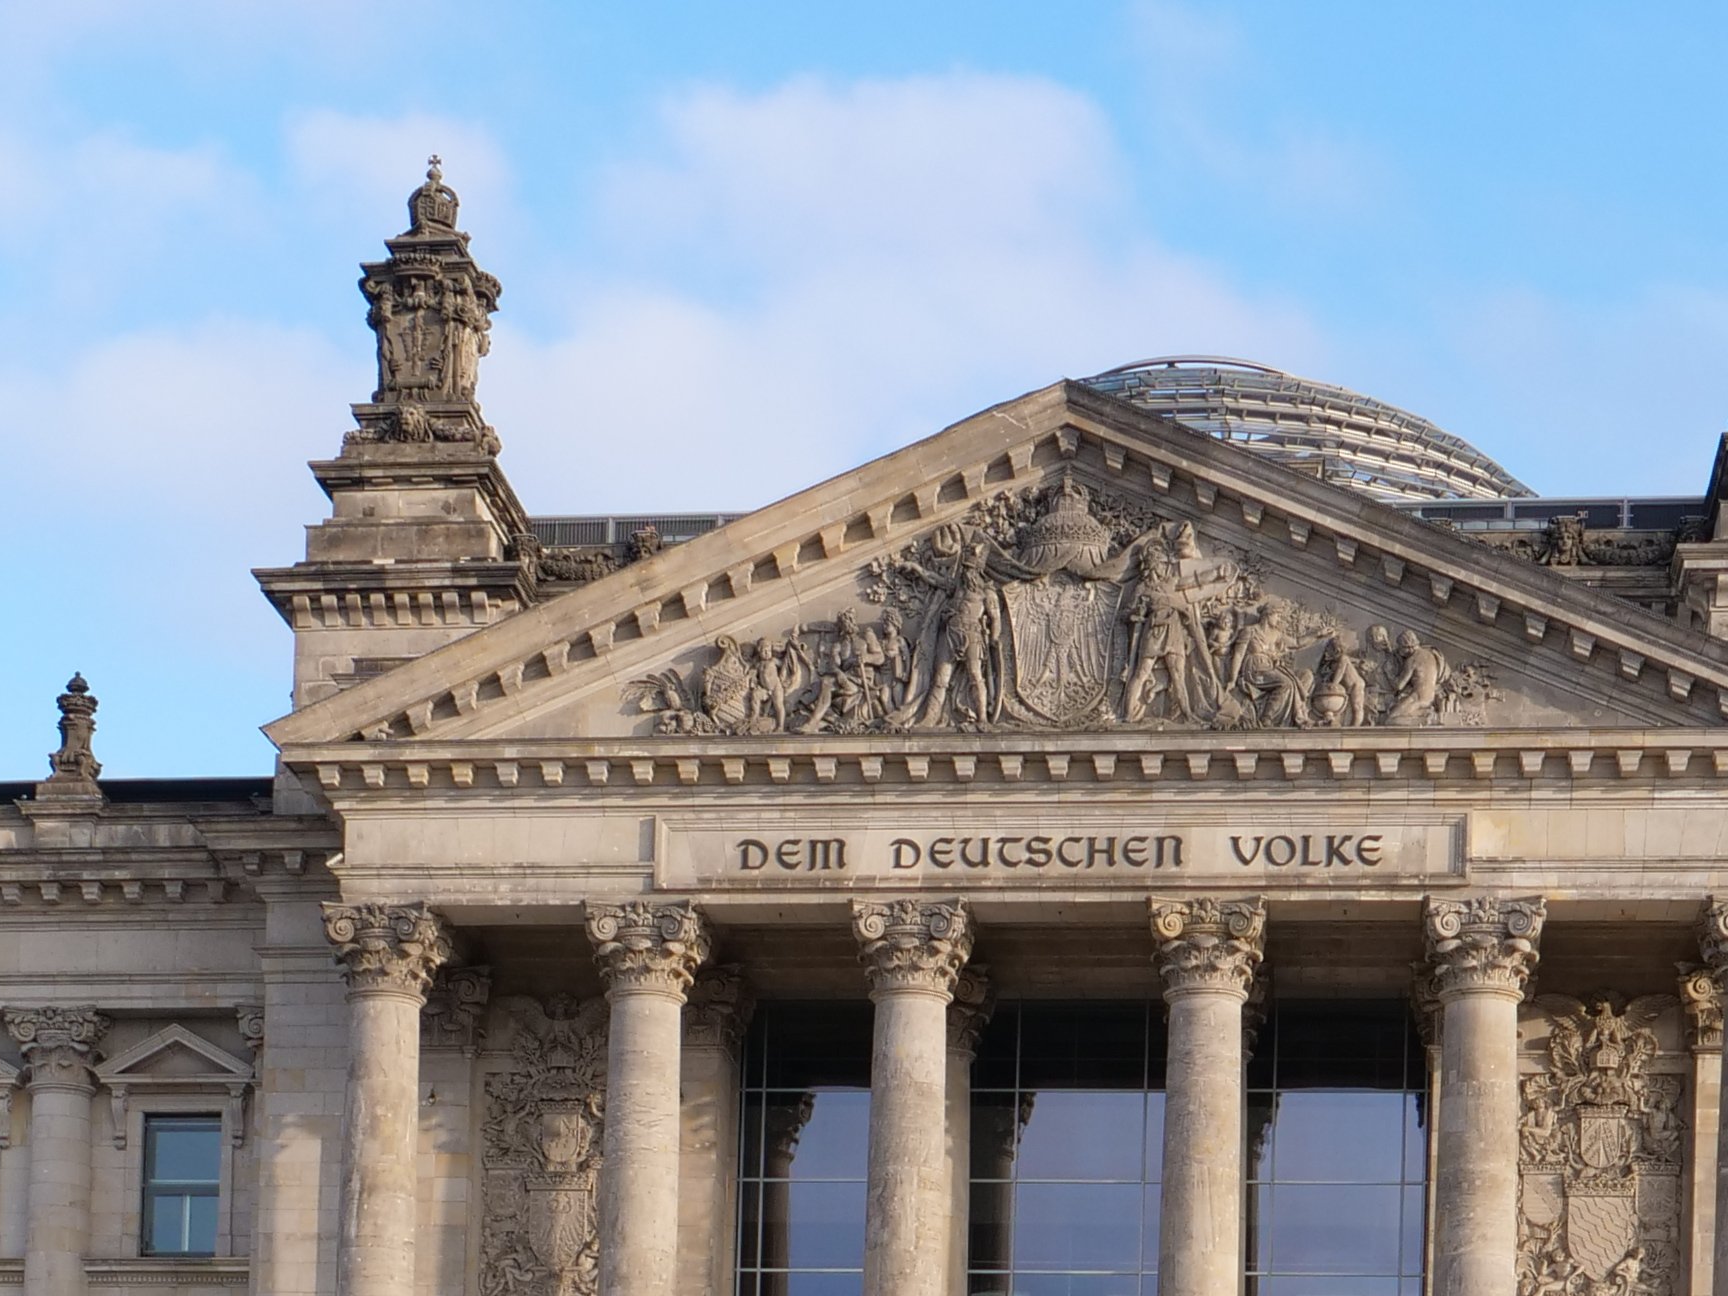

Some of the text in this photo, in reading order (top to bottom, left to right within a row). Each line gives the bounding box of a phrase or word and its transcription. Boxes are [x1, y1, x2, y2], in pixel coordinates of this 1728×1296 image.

[738, 834, 1384, 872] DEM DEUTSCHEN VOLKE
